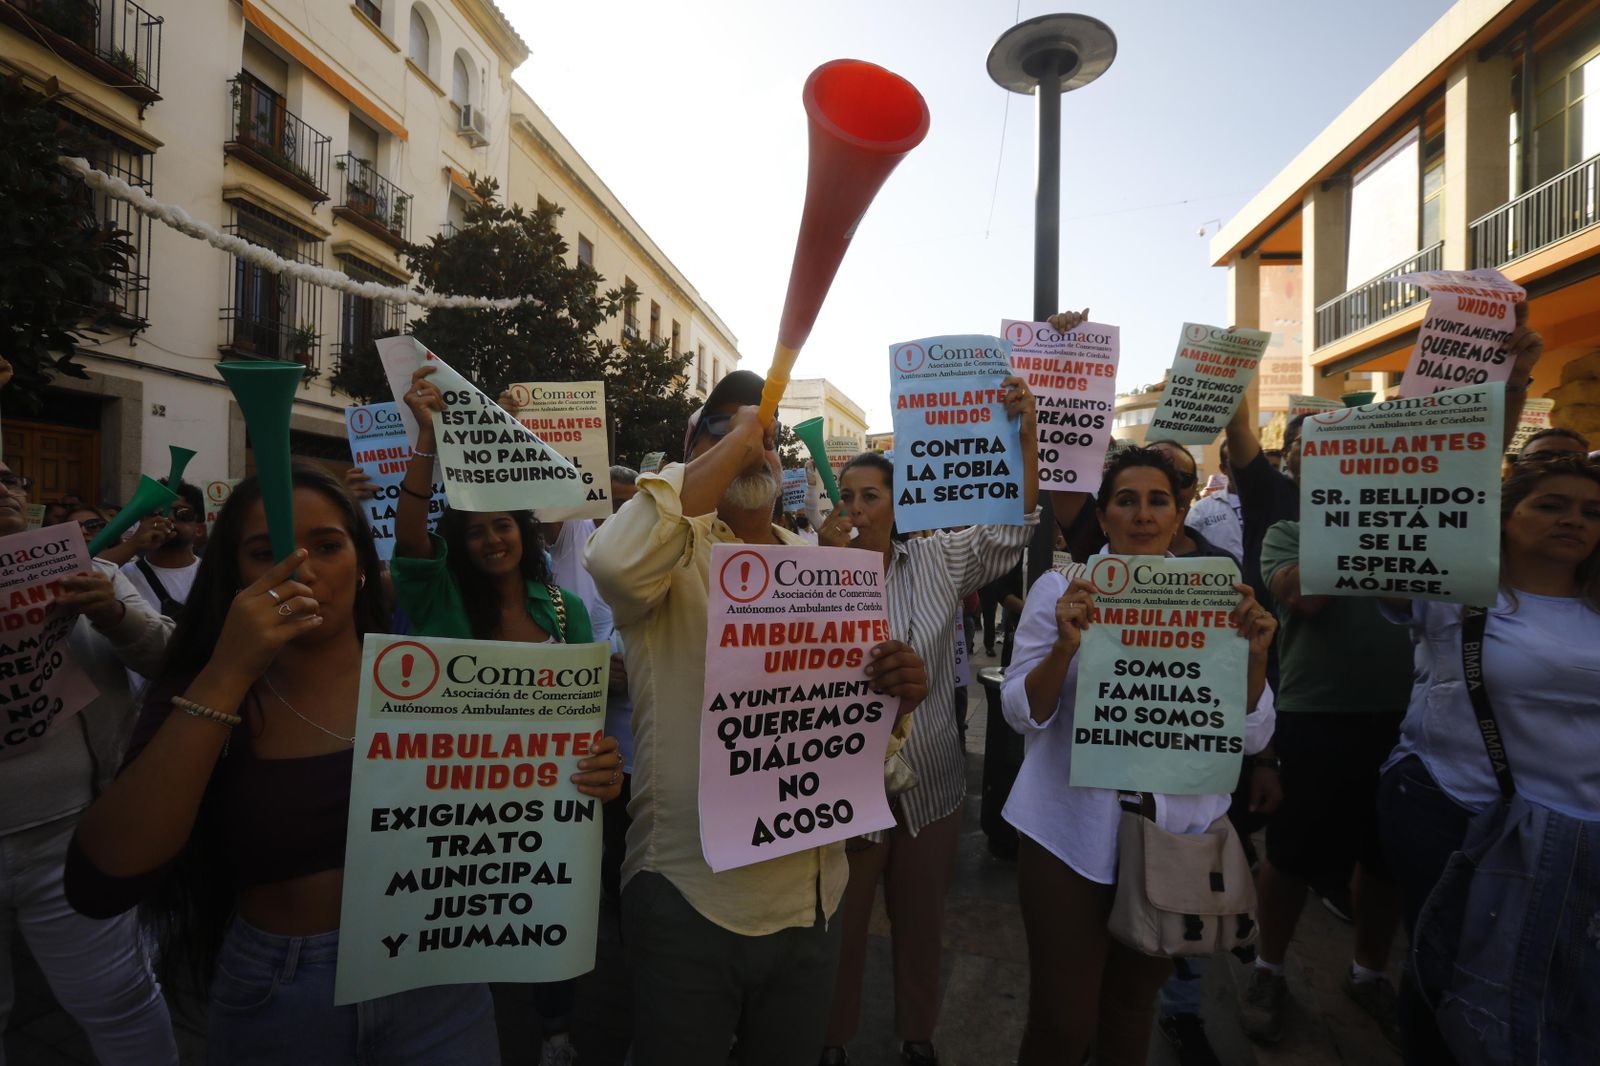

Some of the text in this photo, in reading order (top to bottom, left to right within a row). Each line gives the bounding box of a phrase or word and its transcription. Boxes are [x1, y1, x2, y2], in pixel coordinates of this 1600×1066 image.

[1458, 296, 1507, 320] UNIDOS
[1035, 328, 1111, 345] Comacor
[1210, 329, 1264, 348] Comacor
[1180, 348, 1258, 369] AMBULANTES
[1421, 335, 1508, 365] QUEREMOS
[938, 370, 980, 378] Ambulantes
[1195, 364, 1237, 378] UNIDOS
[1416, 357, 1488, 384] DIÁLOGO
[1028, 374, 1088, 391] UNIDOS
[1172, 375, 1193, 386] LOS
[1197, 378, 1244, 394] TÉCNICOS
[532, 388, 596, 400] Comacor
[897, 389, 1009, 410] AMBULANTE
[1171, 387, 1234, 404] ESTÁN PARA
[924, 407, 991, 425] UNIDOS
[1165, 398, 1231, 416] AYUDARNOS,
[1354, 405, 1488, 421] Asociación de Comerciantes
[521, 417, 602, 430] MBULANTES
[1036, 410, 1105, 429] REMOS
[1153, 419, 1223, 434] PERSEGUIRNOS
[1172, 411, 1215, 424] NO PARA
[1315, 415, 1485, 434] Autónomos Ambulantes de Córdoba
[911, 436, 1006, 457] CONTRA
[1037, 429, 1093, 446] LOGO
[1303, 432, 1487, 457] AMBULANTES
[463, 450, 492, 464] NO
[497, 448, 552, 463] PARA
[1340, 456, 1440, 475] UNIDOS
[445, 466, 577, 483] PERSEGUIRNOS
[906, 459, 1010, 481] LA FOBIA
[1038, 468, 1077, 483] OSO
[898, 482, 1019, 506] AL SECTOR
[1311, 487, 1486, 505] SR. BELLIDO:
[371, 504, 396, 520] LA
[1325, 505, 1467, 529] NI ESTÁ NI
[370, 525, 394, 538] AL
[1359, 534, 1427, 551] SE LE
[2, 553, 77, 577] de Comerciantes
[27, 573, 40, 581] de
[41, 563, 78, 577] Córdoba
[774, 560, 878, 587] Comacor
[1337, 556, 1449, 576] ESPERA.
[1134, 565, 1236, 586] Comacor
[1335, 573, 1452, 595] MÓJESE.
[772, 589, 824, 599] Asociación
[826, 589, 837, 598] de
[1095, 595, 1237, 607] Autónomos Ambulantes de Córdoba
[1130, 587, 1173, 595] Asociación
[1187, 588, 1239, 596] Comerciantes
[726, 603, 786, 615] Autónomos
[788, 603, 842, 613] Ambulantes
[844, 603, 855, 612] de
[720, 619, 890, 648] AMBULANTES
[1121, 629, 1206, 649] UNIDOS
[447, 654, 602, 688] Comacor
[764, 648, 863, 674] UNIDOS
[1114, 659, 1201, 680] SOMOS
[442, 687, 509, 699] Asociación
[514, 689, 528, 699] de
[1098, 682, 1220, 708] FAMILIAS,
[8, 695, 48, 723] NO
[381, 701, 458, 715] Autónomos
[462, 703, 536, 716] Ambulantes
[538, 705, 553, 715] de
[1094, 705, 1225, 729] NO SOMOS
[717, 701, 884, 750] QUEREMOS
[1075, 728, 1243, 754] DELINCUENTES
[729, 732, 866, 776] DIÁLOGO
[425, 762, 558, 790] UNIDOS
[778, 771, 820, 802] NO
[370, 800, 595, 832] EXIGIMOS UN
[751, 799, 854, 847] ACOSO
[426, 831, 543, 858] TRATO
[385, 862, 573, 896] MUNICIPAL
[424, 893, 533, 921] JUSTO
[381, 923, 568, 958] Y HUMANO
